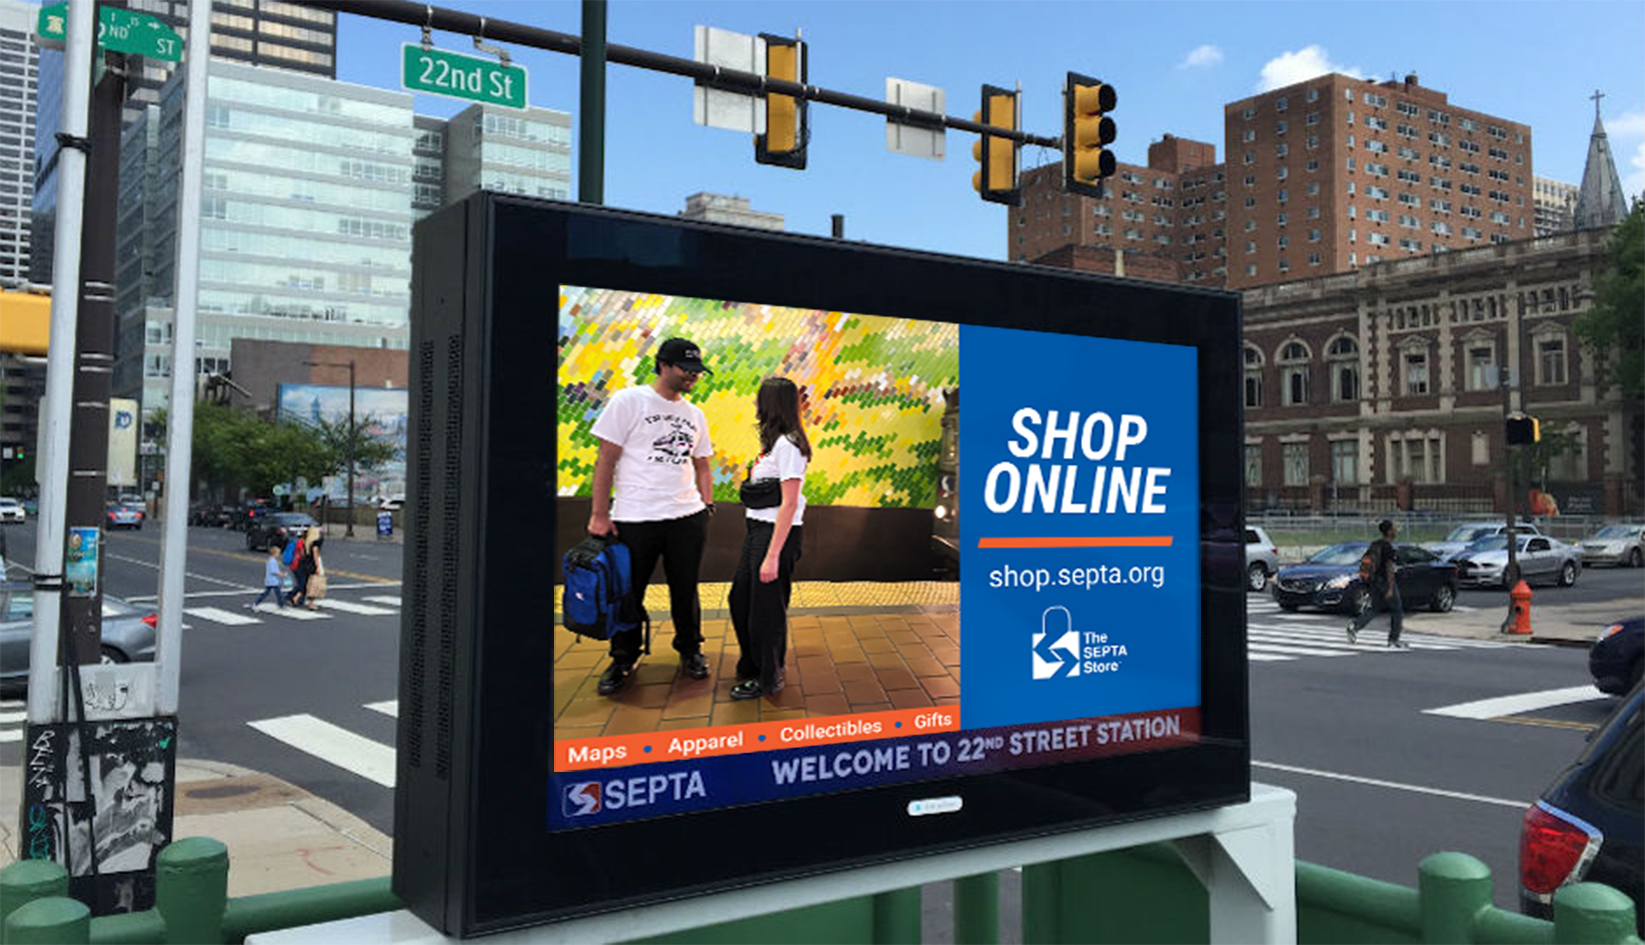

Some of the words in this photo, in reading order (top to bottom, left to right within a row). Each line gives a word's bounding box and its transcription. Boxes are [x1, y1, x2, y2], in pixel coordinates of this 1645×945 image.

[156, 38, 175, 55] ST
[419, 56, 482, 93] 22nd
[489, 71, 514, 99] St
[1007, 407, 1148, 461] SHOP
[984, 461, 1172, 514] ONLINE
[989, 564, 1165, 592] shop.septa.org
[1083, 631, 1108, 645] The
[1083, 645, 1128, 659] SEPTA
[567, 746, 628, 765] Maps
[667, 730, 744, 757] Apparel
[779, 719, 883, 743] Collectibles
[914, 711, 953, 730] Gifts
[771, 746, 911, 785] WELCOME
[917, 740, 951, 766] TO
[957, 735, 1004, 762] 22ND
[1009, 724, 1093, 755] STREET
[1096, 714, 1181, 745] STATION
[604, 770, 708, 810] SEPTA
